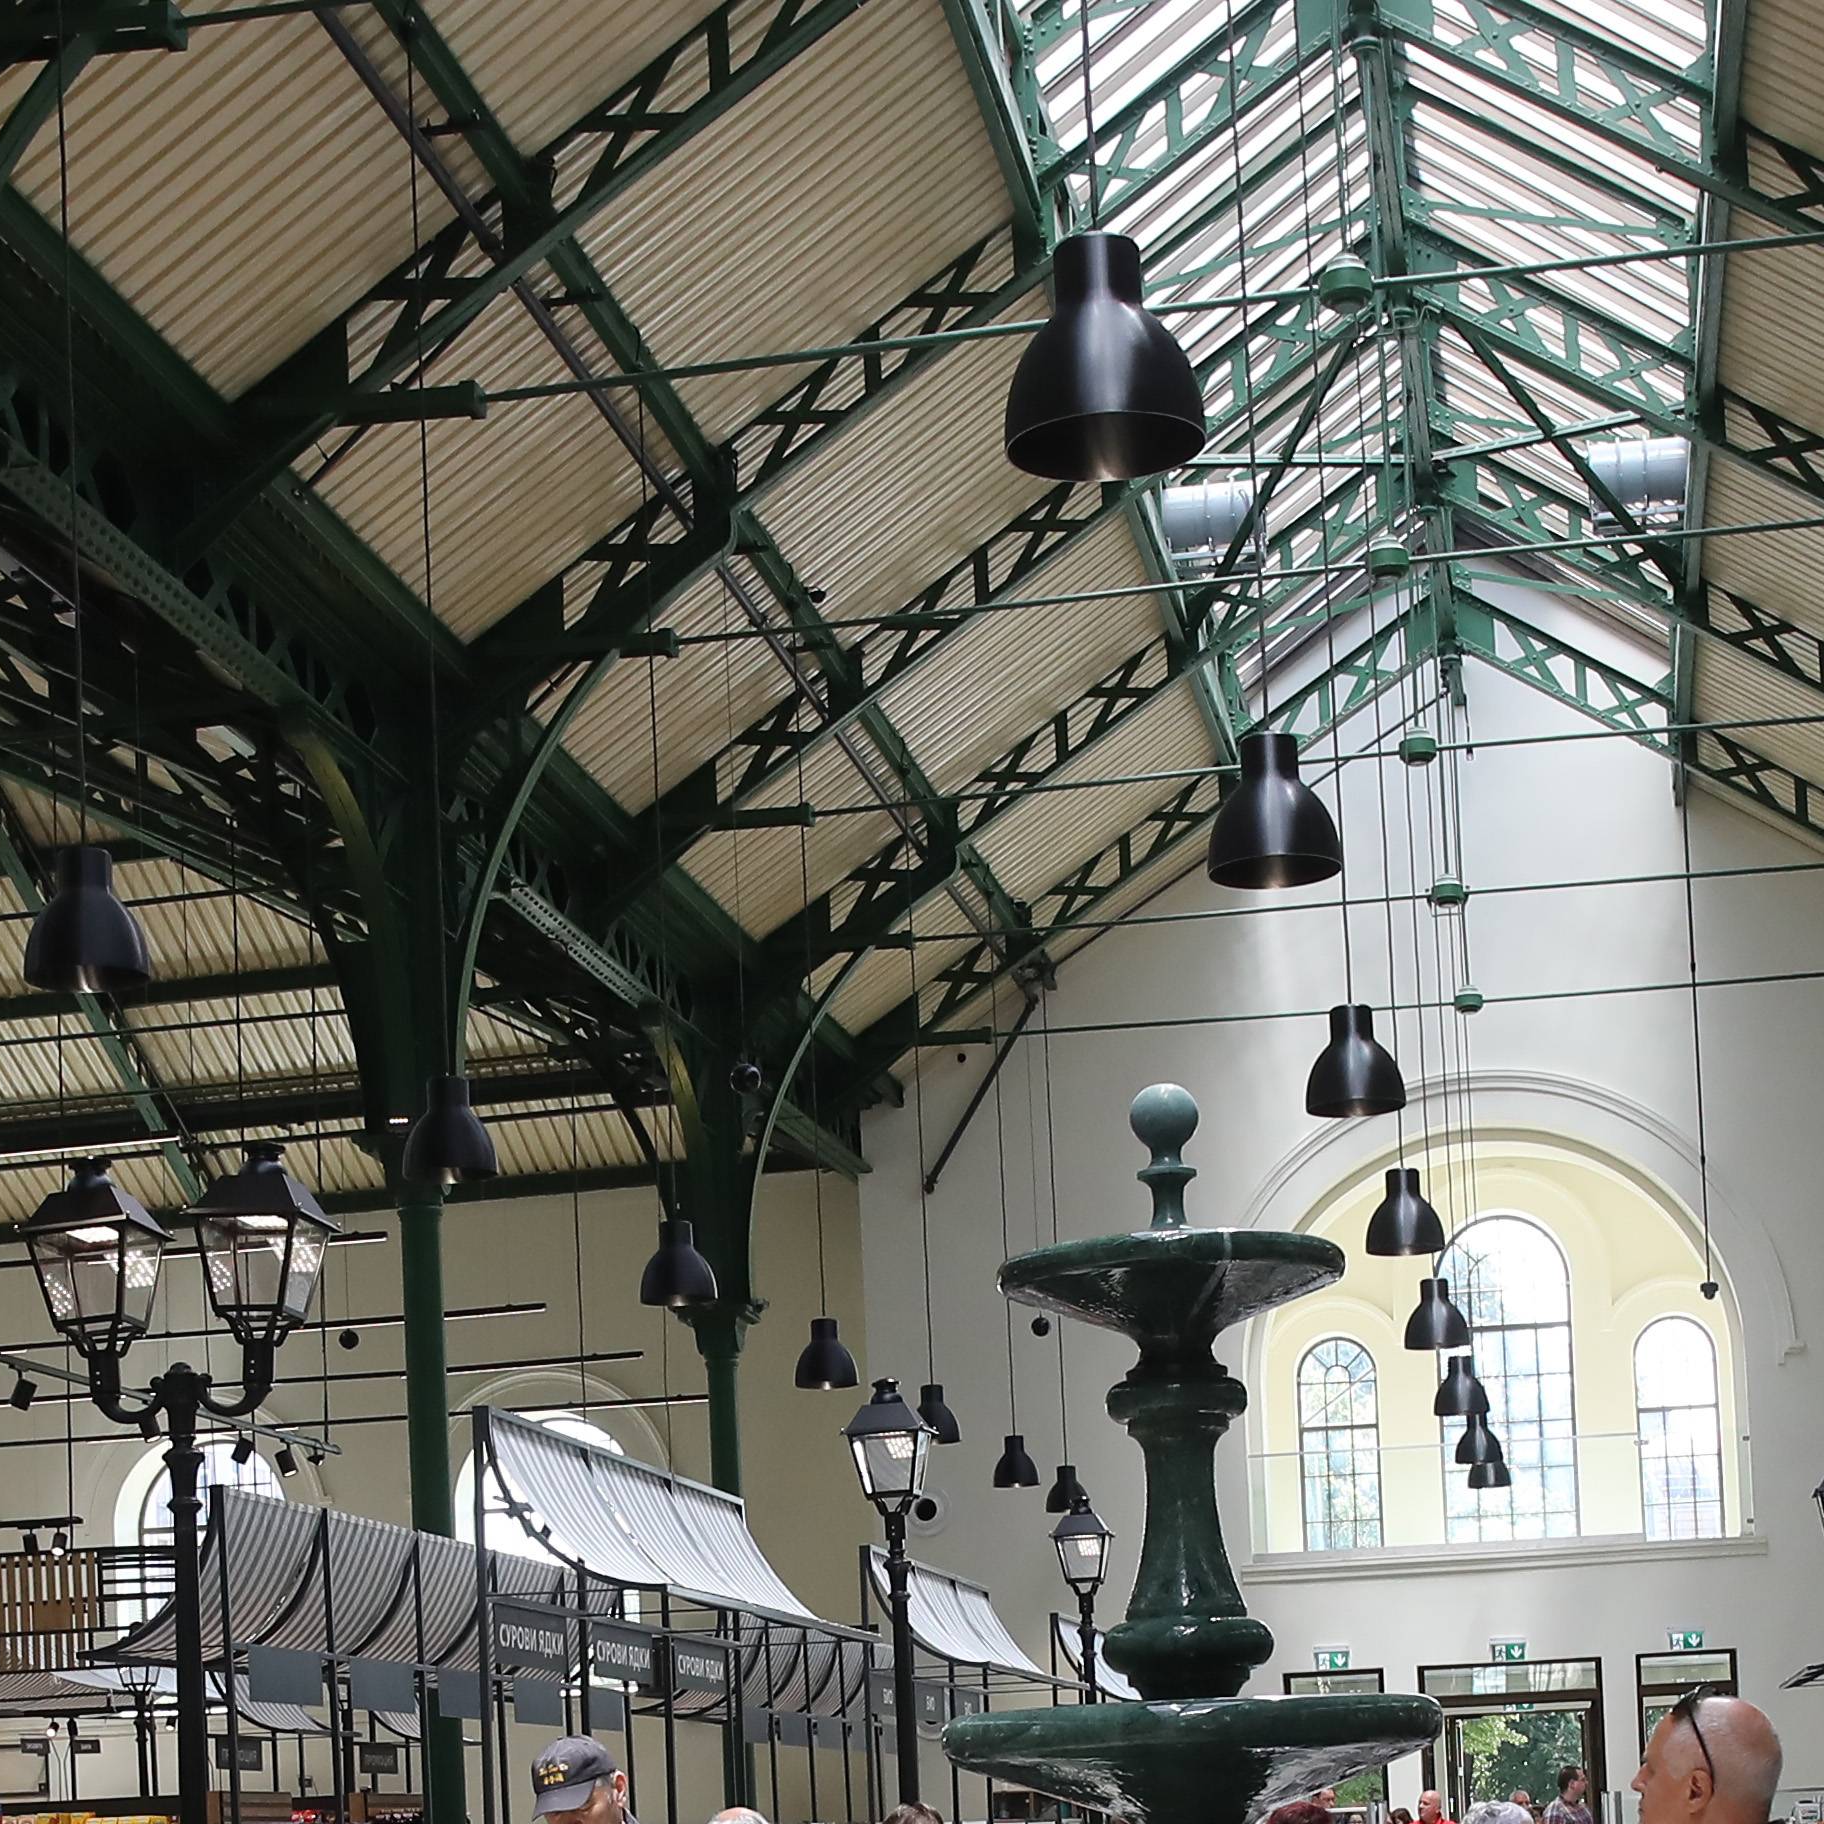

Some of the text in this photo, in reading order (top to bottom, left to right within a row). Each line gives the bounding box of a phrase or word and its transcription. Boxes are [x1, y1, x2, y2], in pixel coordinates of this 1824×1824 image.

[499, 1623, 564, 1659] СУРОВИ ЯДКИ
[596, 1639, 651, 1672] СУРОВИ ЯДКИ
[677, 1654, 724, 1683] СУРОВИ ЯДКИ
